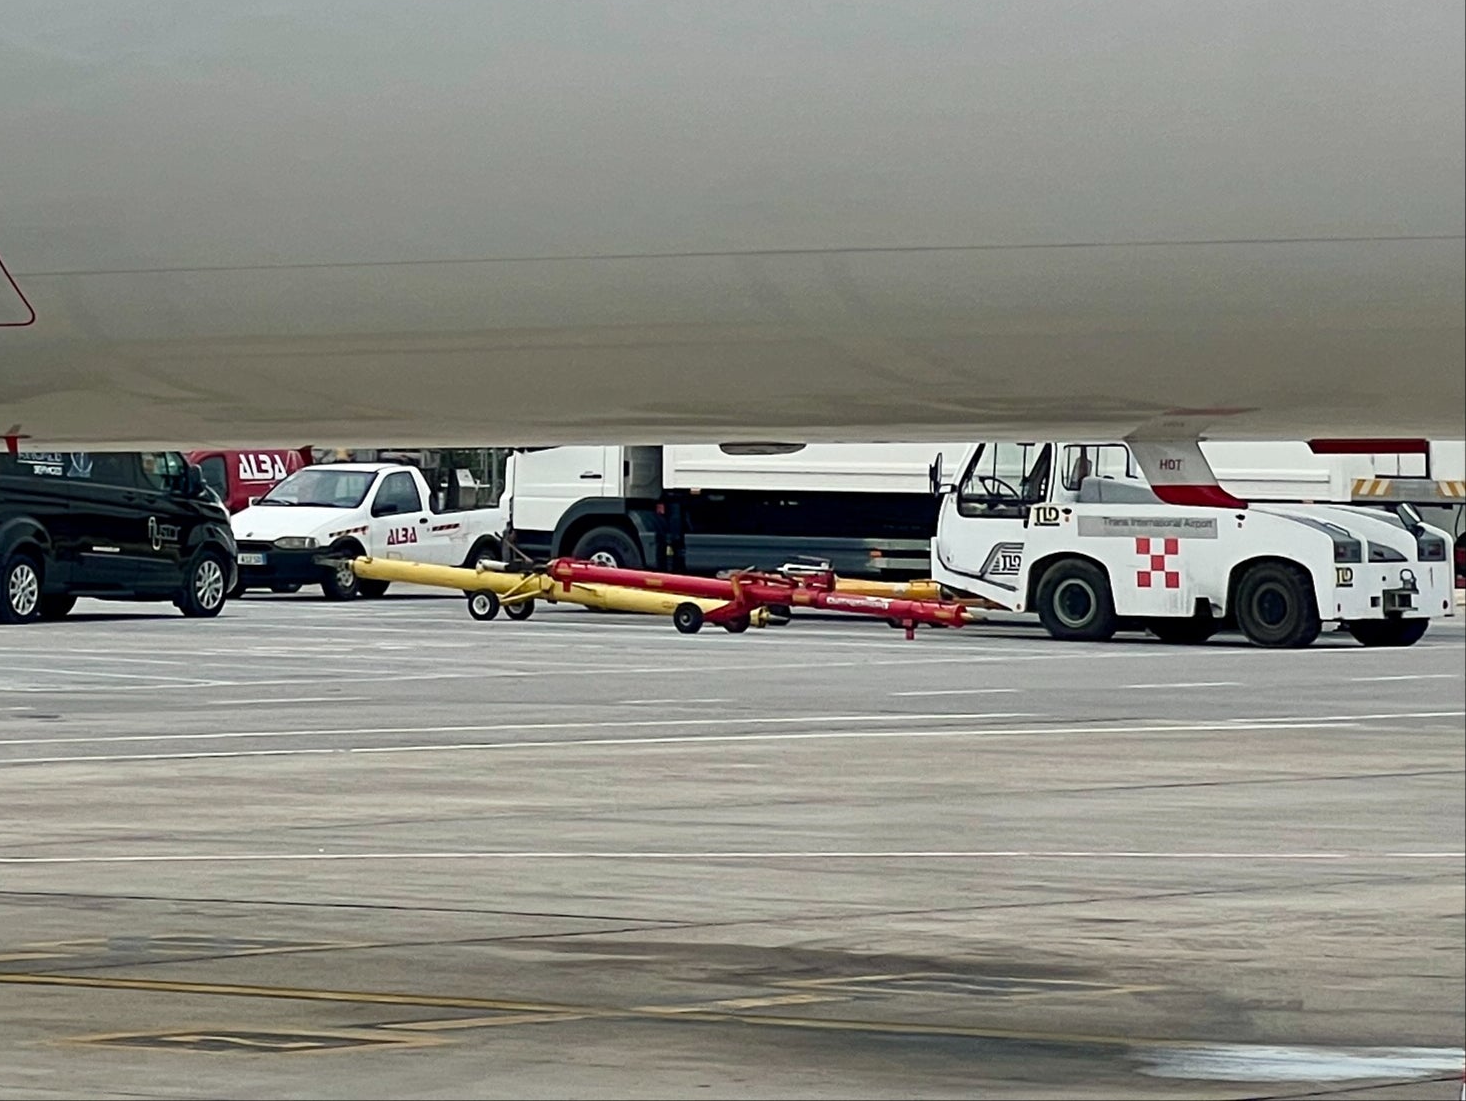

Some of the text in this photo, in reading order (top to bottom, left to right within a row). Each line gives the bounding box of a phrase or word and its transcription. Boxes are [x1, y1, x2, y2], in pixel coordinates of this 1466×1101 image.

[239, 453, 288, 480] ALBA
[1159, 459, 1182, 470] HOT
[1035, 506, 1059, 523] TLD
[1184, 518, 1212, 529] Airport
[387, 527, 418, 546] ALBA
